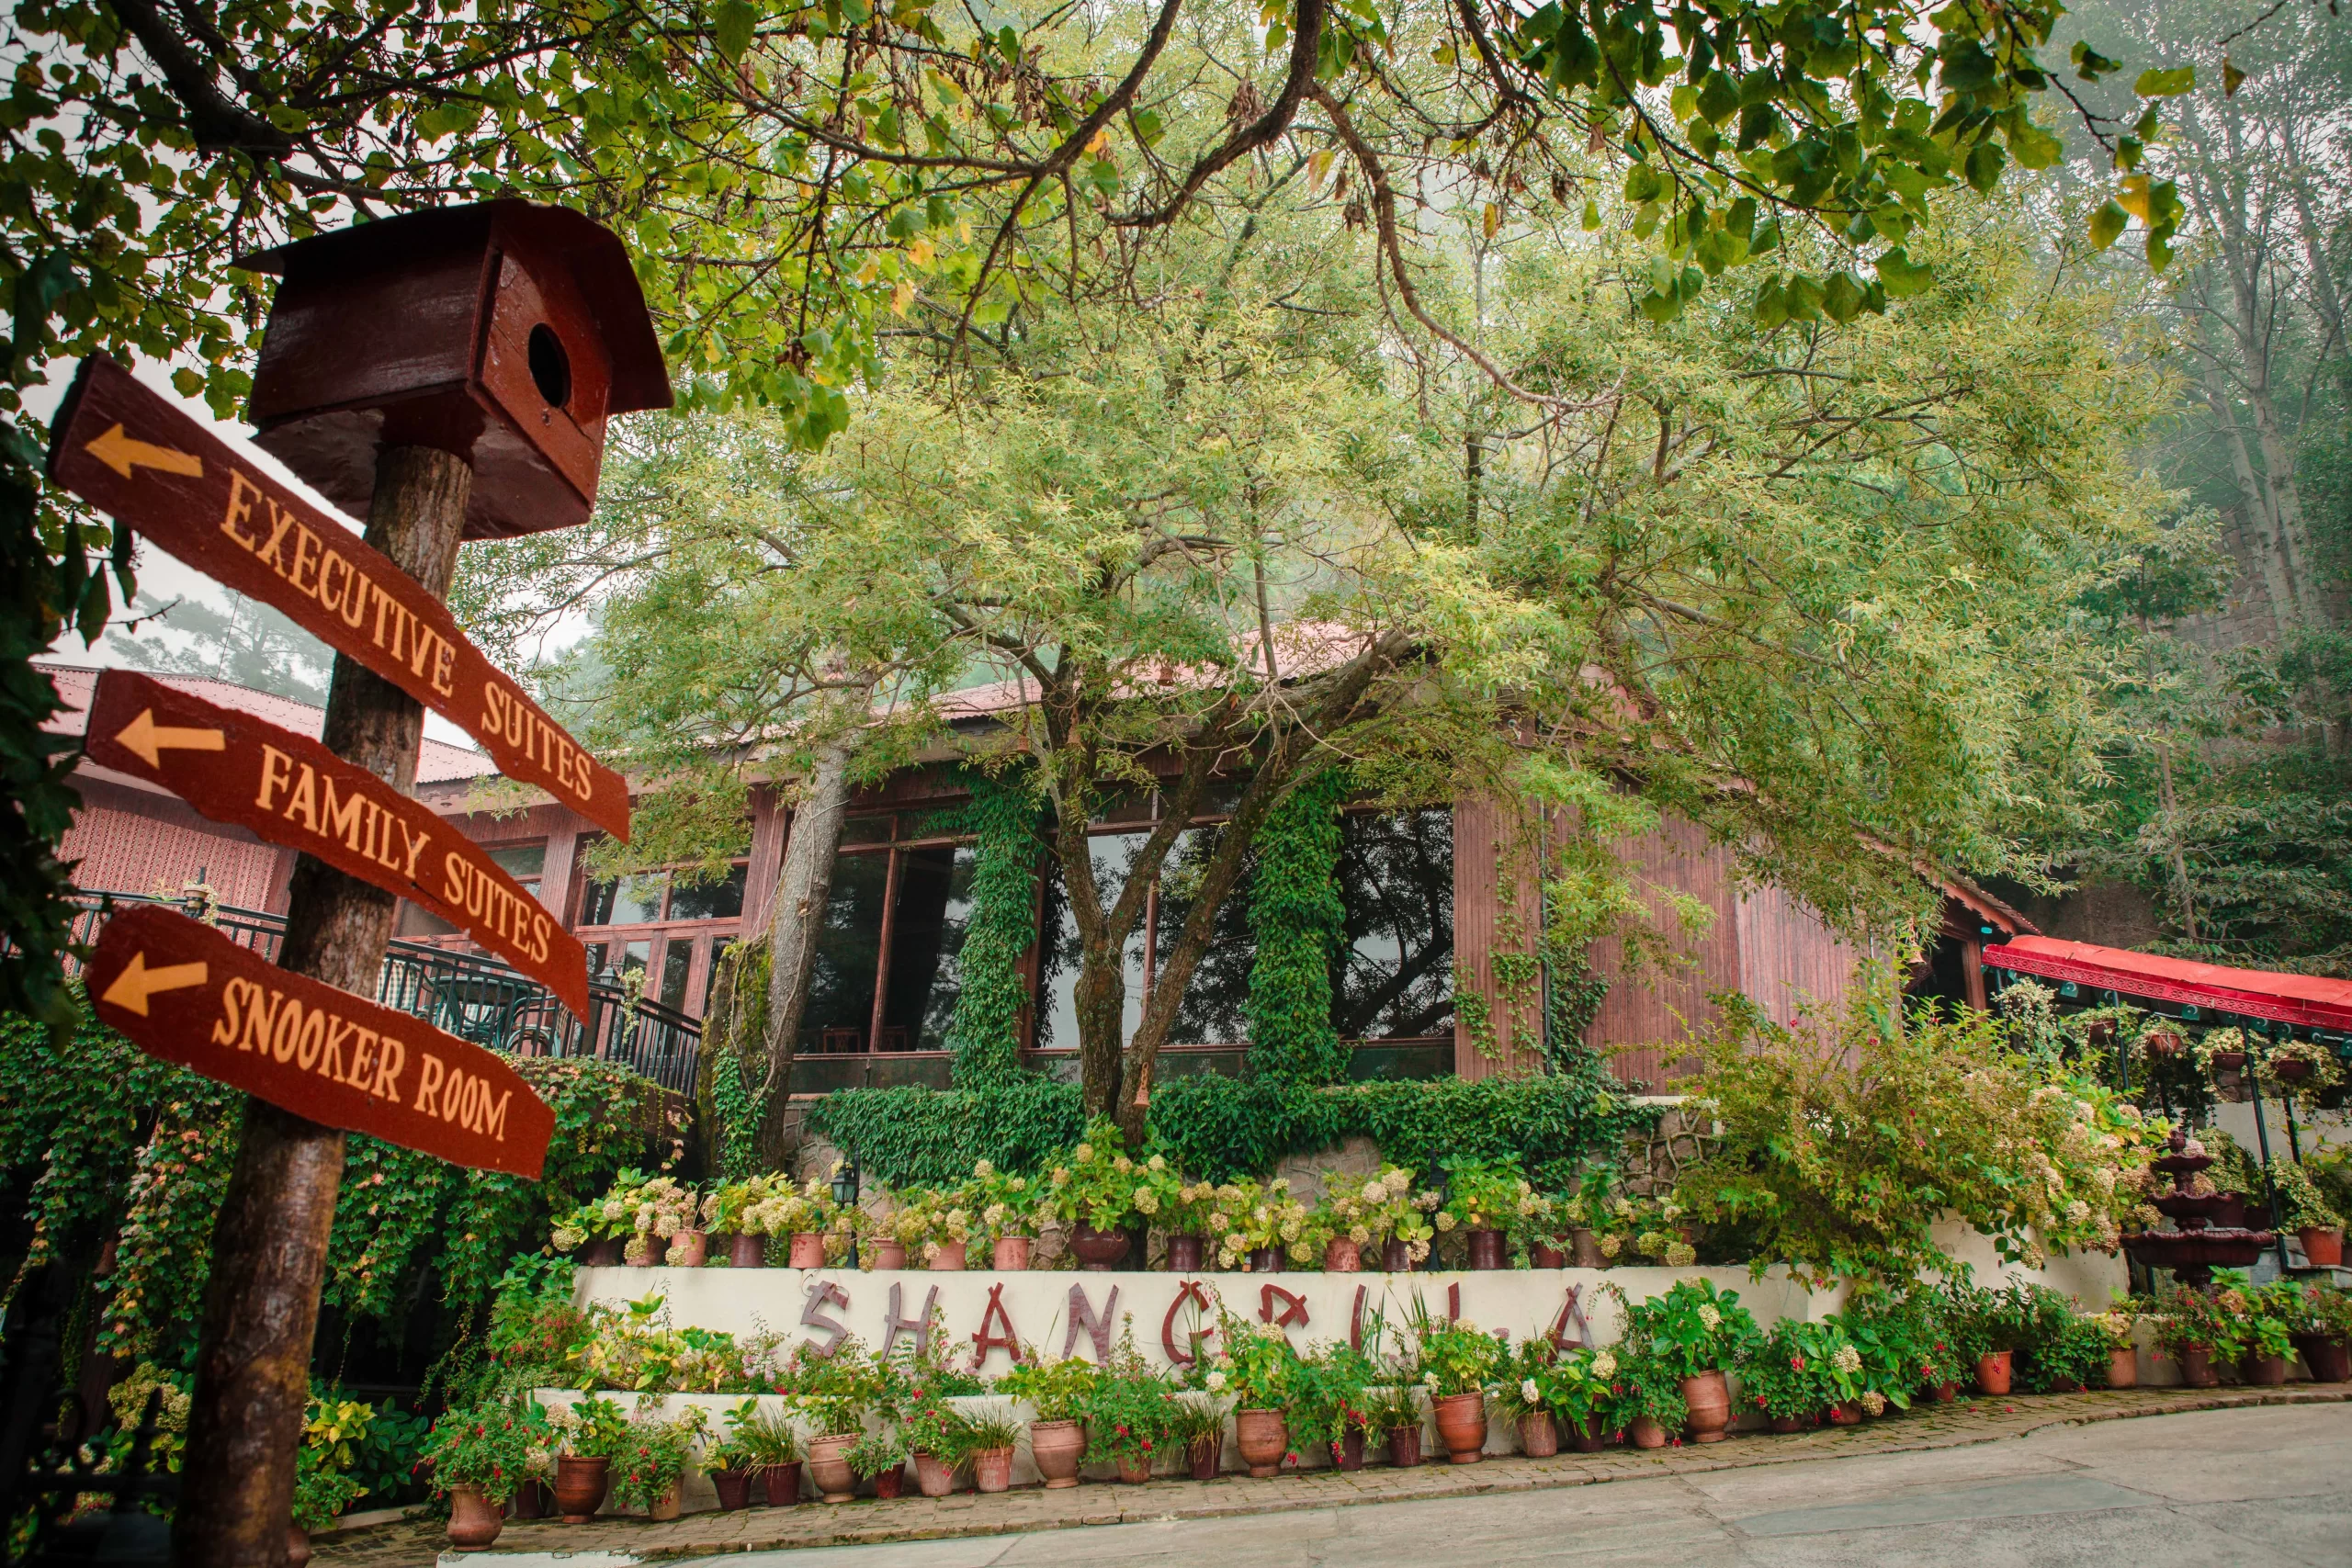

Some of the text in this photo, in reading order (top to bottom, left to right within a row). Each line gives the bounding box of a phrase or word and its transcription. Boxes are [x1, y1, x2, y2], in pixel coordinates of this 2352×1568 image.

[220, 468, 593, 801] EXECUTIVE SUITES
[255, 743, 552, 964] FAMILY SUITES
[211, 976, 513, 1143] SNOOKER ROOM
